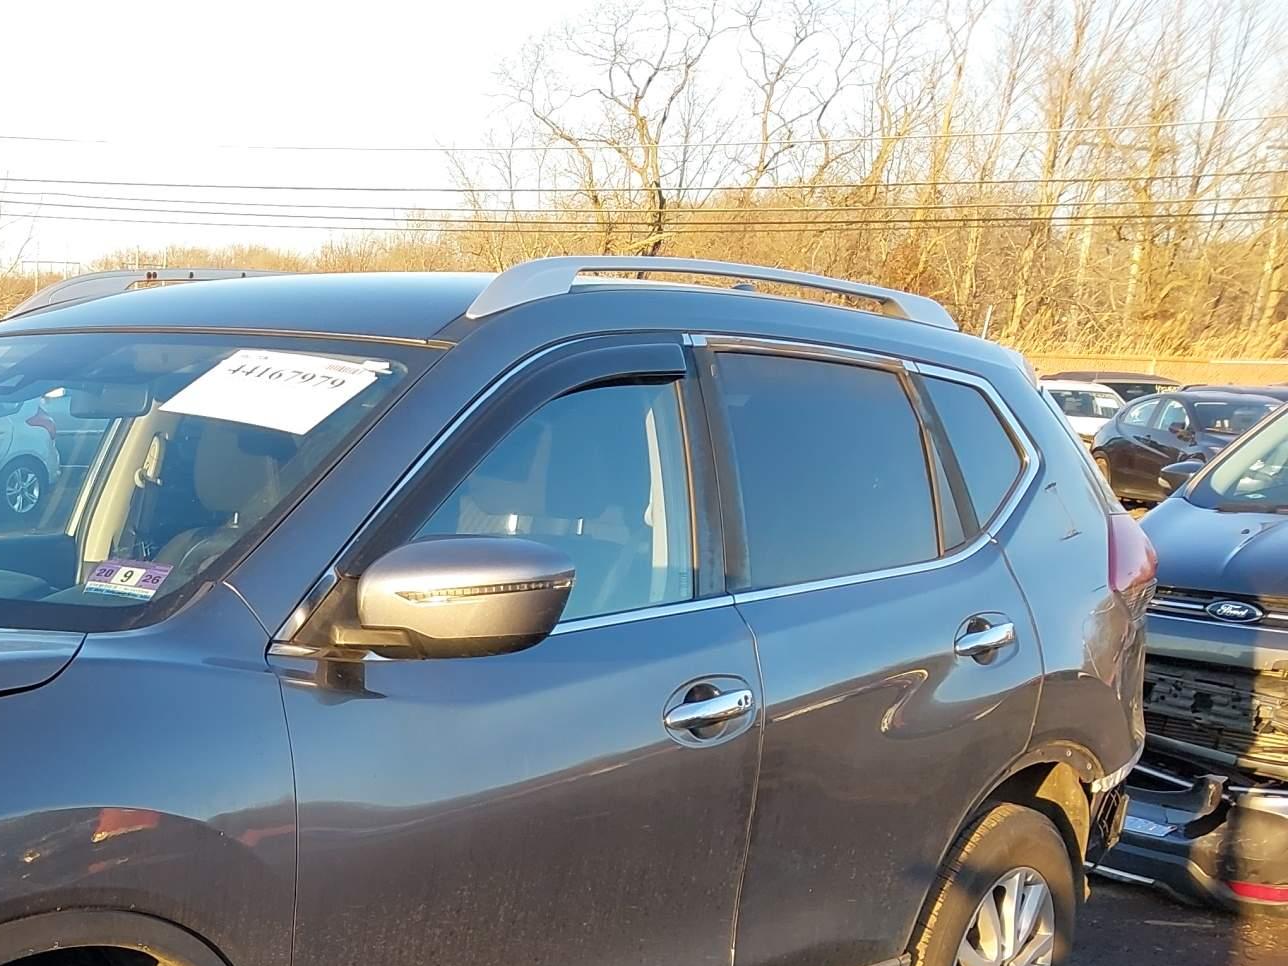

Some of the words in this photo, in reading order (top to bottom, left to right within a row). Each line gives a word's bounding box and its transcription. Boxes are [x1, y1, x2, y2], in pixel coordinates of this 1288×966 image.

[227, 364, 346, 388] 44167979
[96, 568, 114, 578] 20
[121, 570, 134, 583] 9
[142, 574, 162, 584] 26
[1216, 604, 1249, 618] Ford
